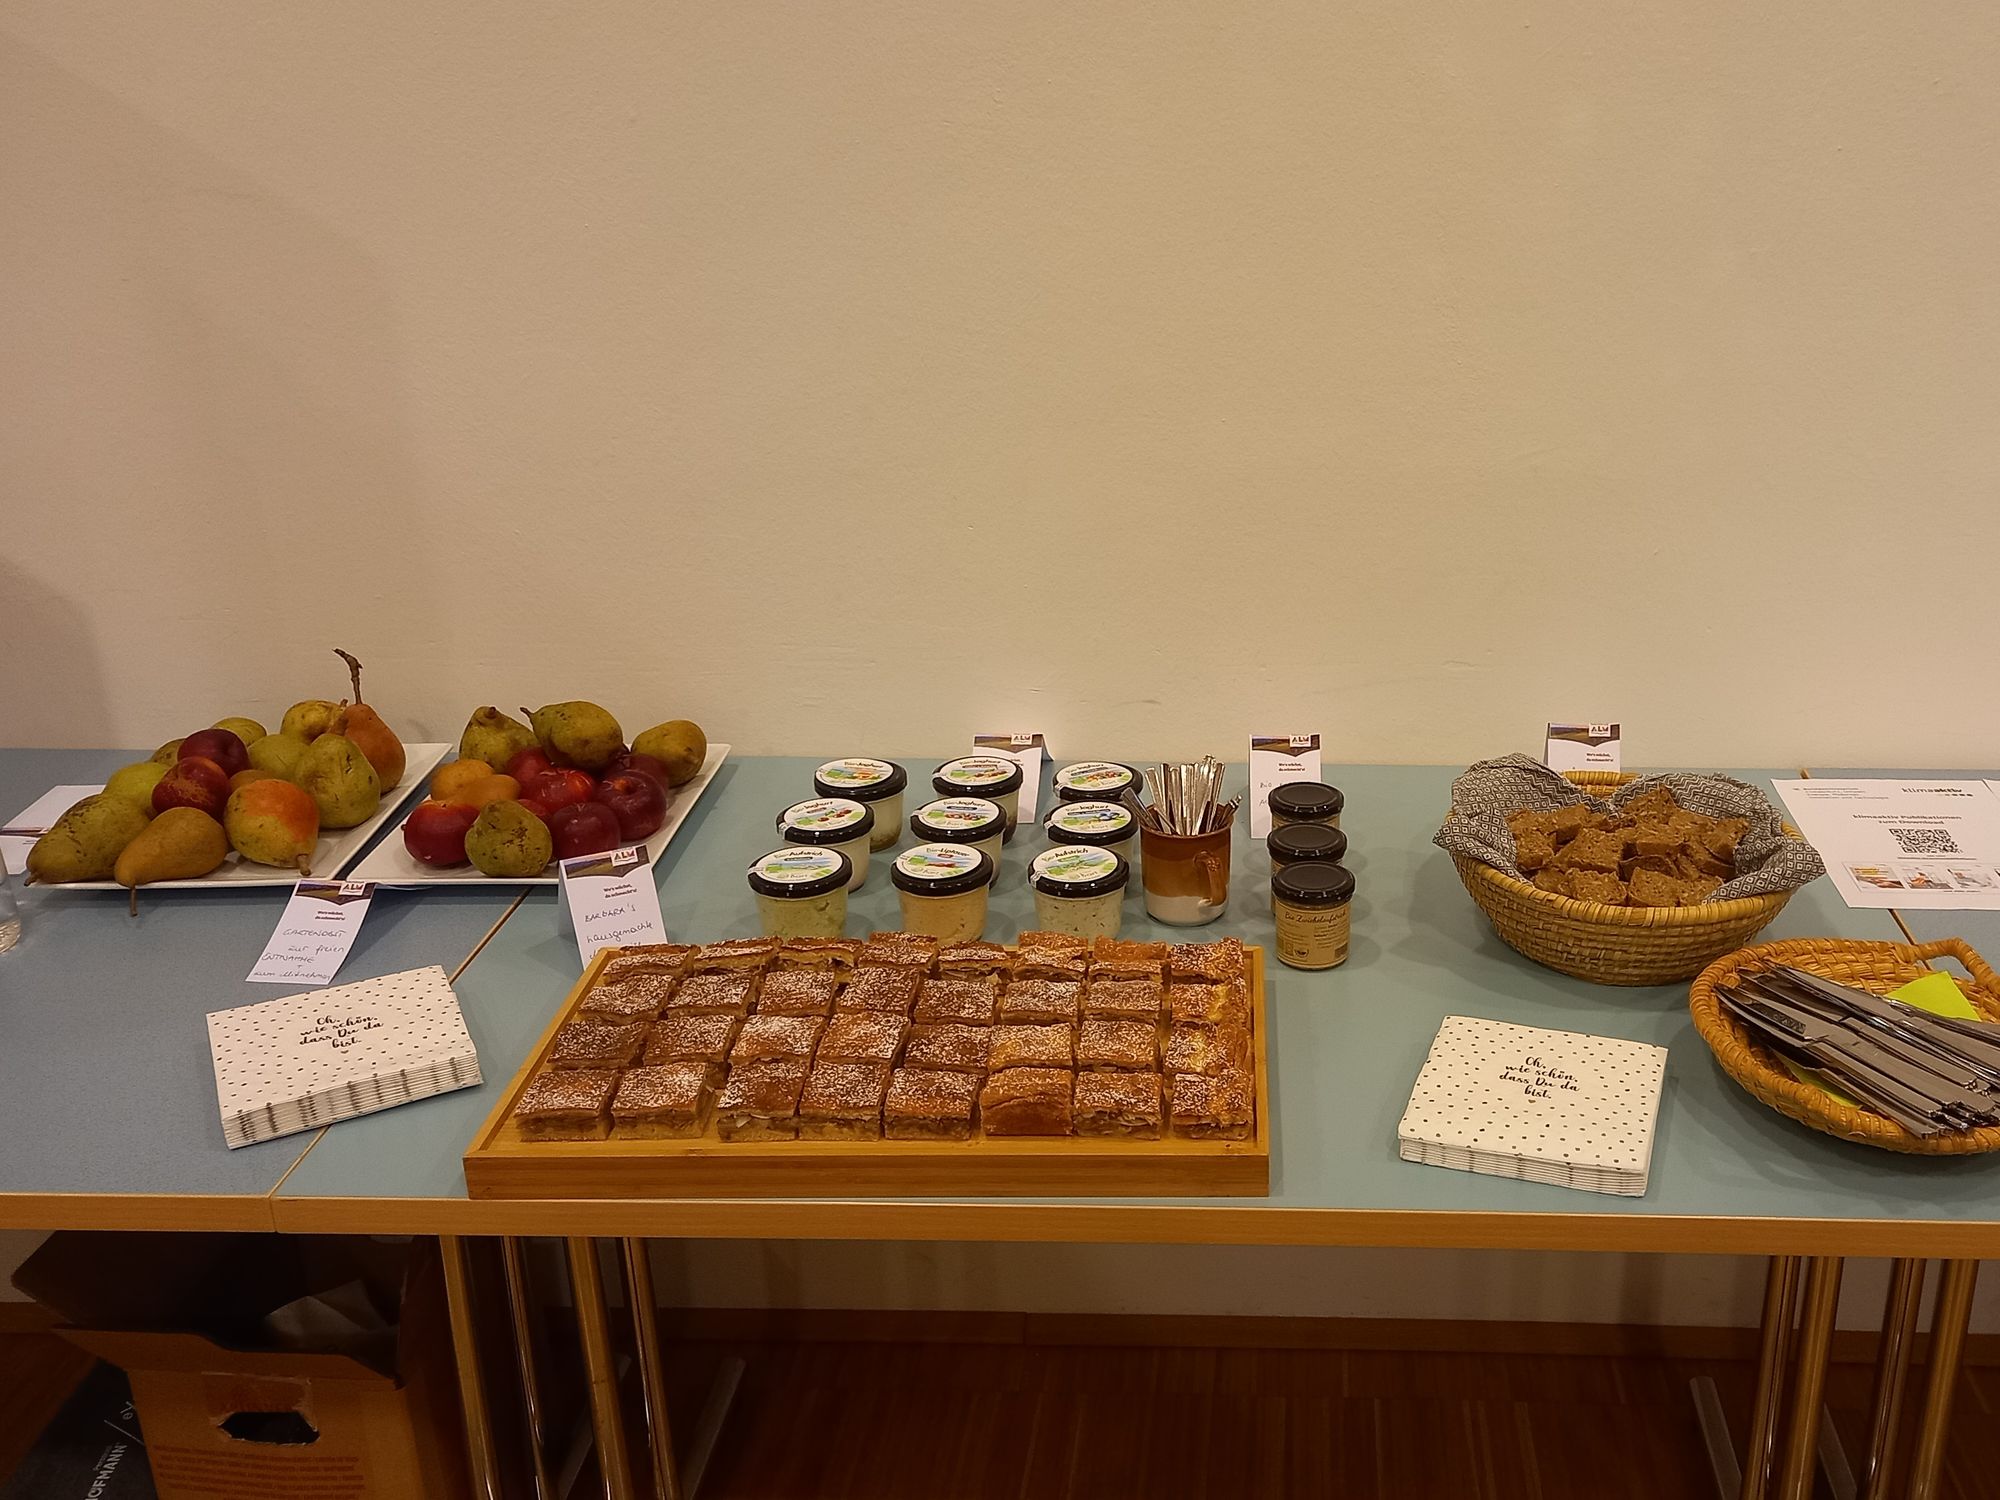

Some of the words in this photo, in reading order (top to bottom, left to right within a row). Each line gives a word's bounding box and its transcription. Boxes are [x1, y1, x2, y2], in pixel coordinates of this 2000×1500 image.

[299, 1035, 332, 1045] dass
[337, 1028, 359, 1038] Du
[363, 1022, 384, 1030] da
[300, 1026, 328, 1036] wie
[1505, 1065, 1531, 1073] wie
[1499, 1071, 1530, 1084] dass
[1535, 1077, 1557, 1087] Du
[1560, 1081, 1580, 1092] da
